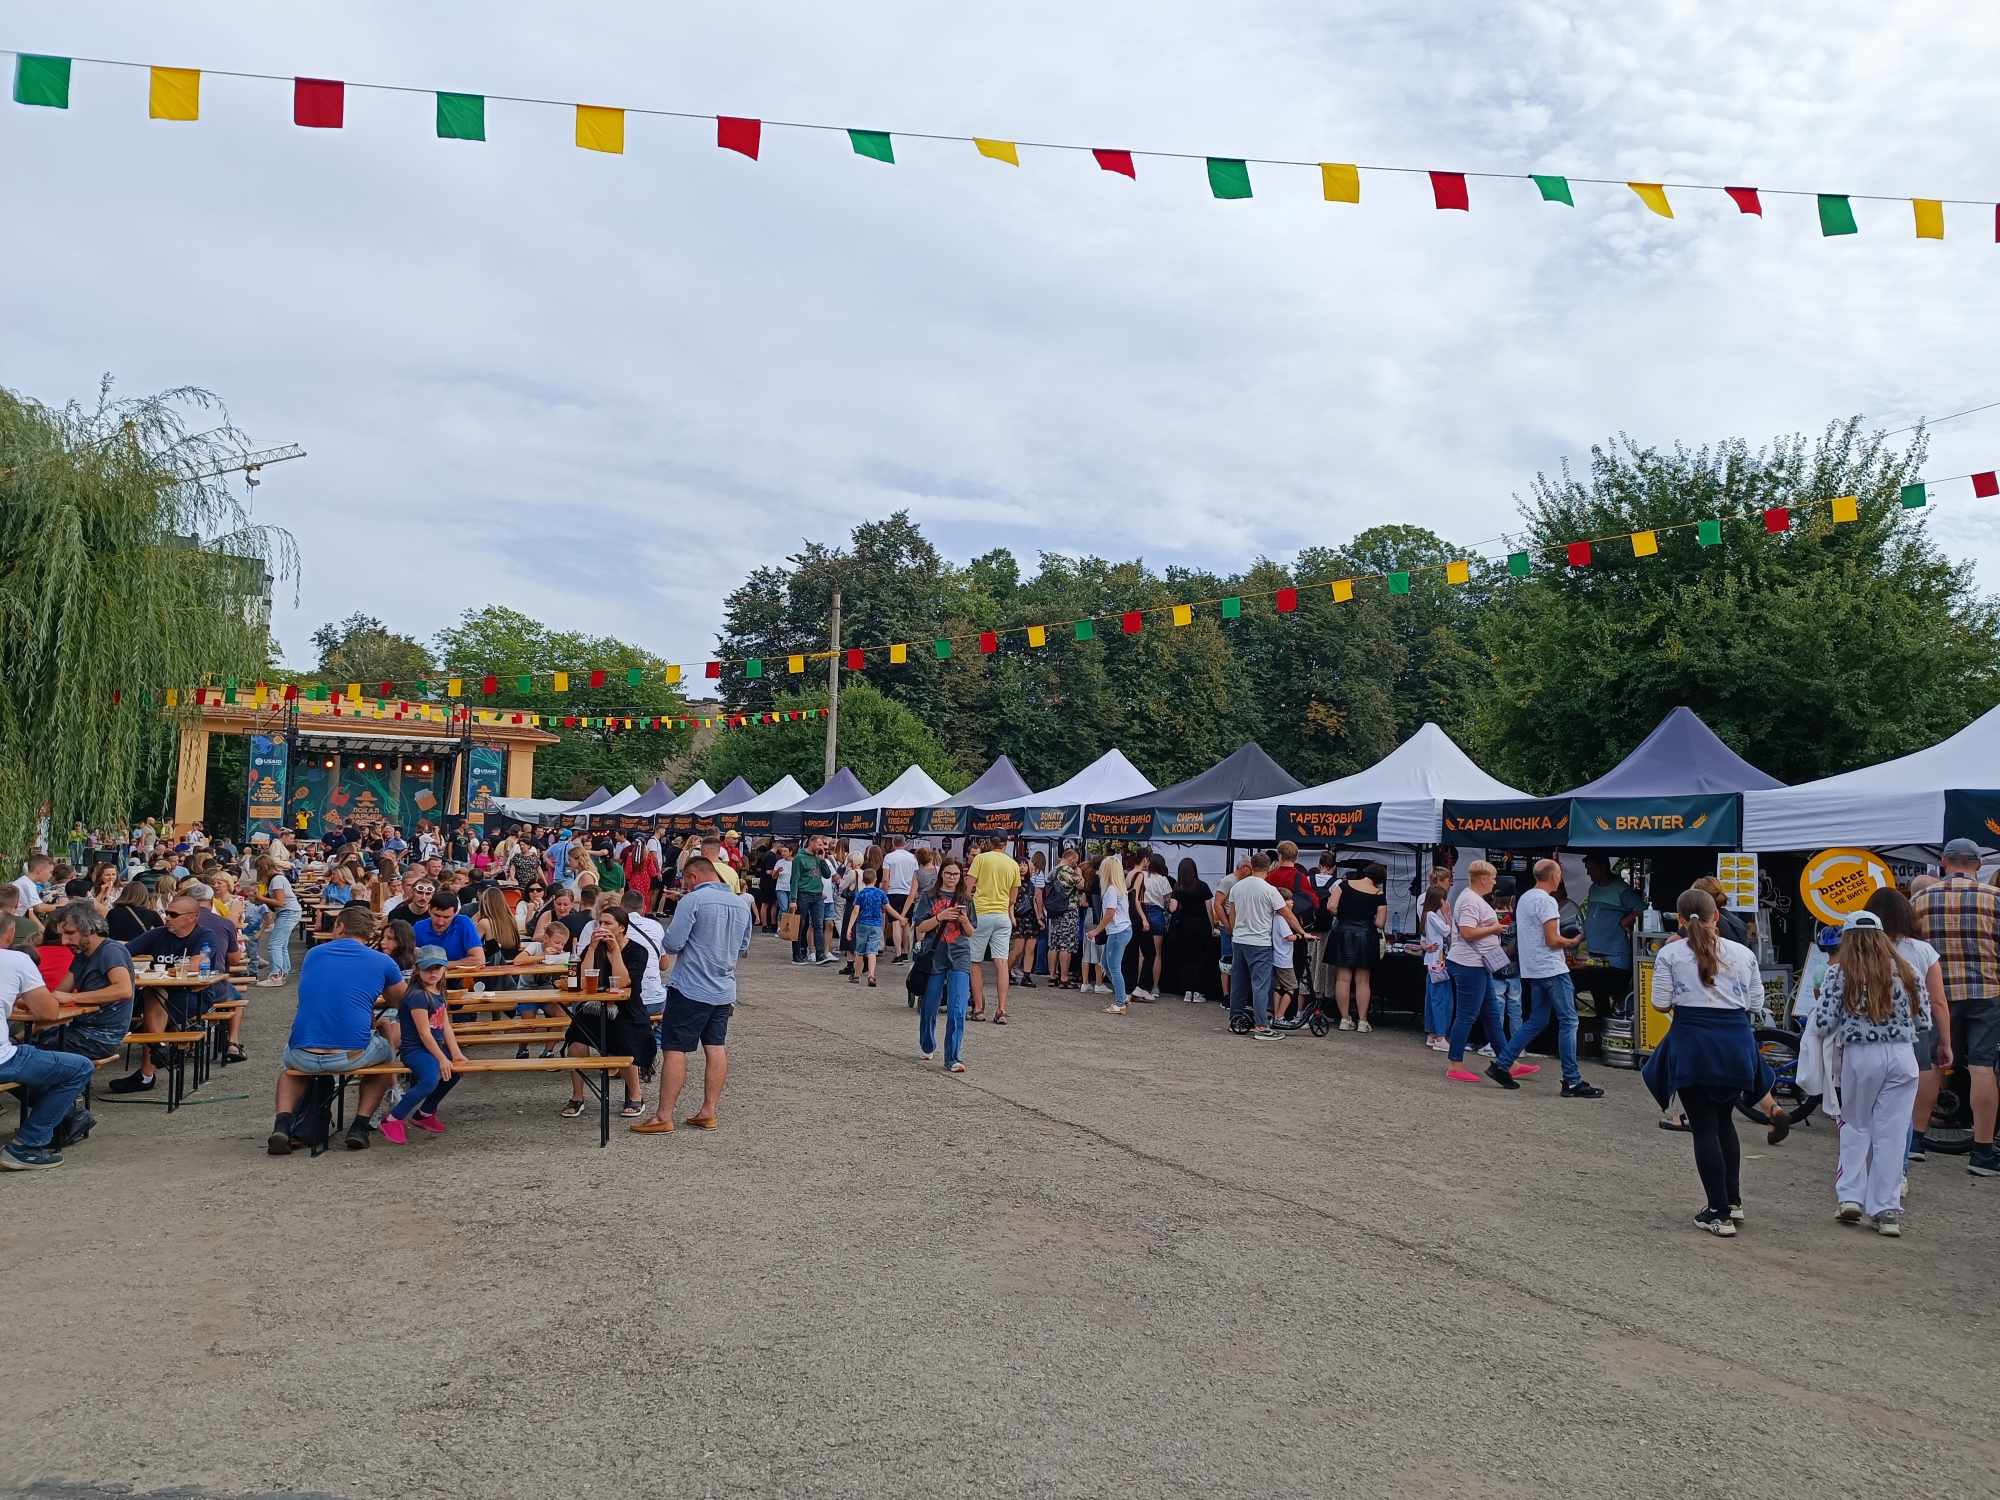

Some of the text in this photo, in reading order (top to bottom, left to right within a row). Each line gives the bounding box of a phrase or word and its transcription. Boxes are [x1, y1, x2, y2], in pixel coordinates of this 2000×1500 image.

[1130, 814, 1152, 825] ВИНО
[1177, 813, 1204, 821] СИРНА
[1290, 809, 1363, 824] ГАРБУЗОВИЙ
[1457, 816, 1552, 831] ZAPALNICHKA
[1615, 815, 1684, 830] BRATER
[1171, 823, 1205, 833] КОМОРА
[1313, 823, 1336, 836] РАЙ
[1818, 870, 1864, 895] brater
[1830, 879, 1866, 899] САМ СЕБЕ
